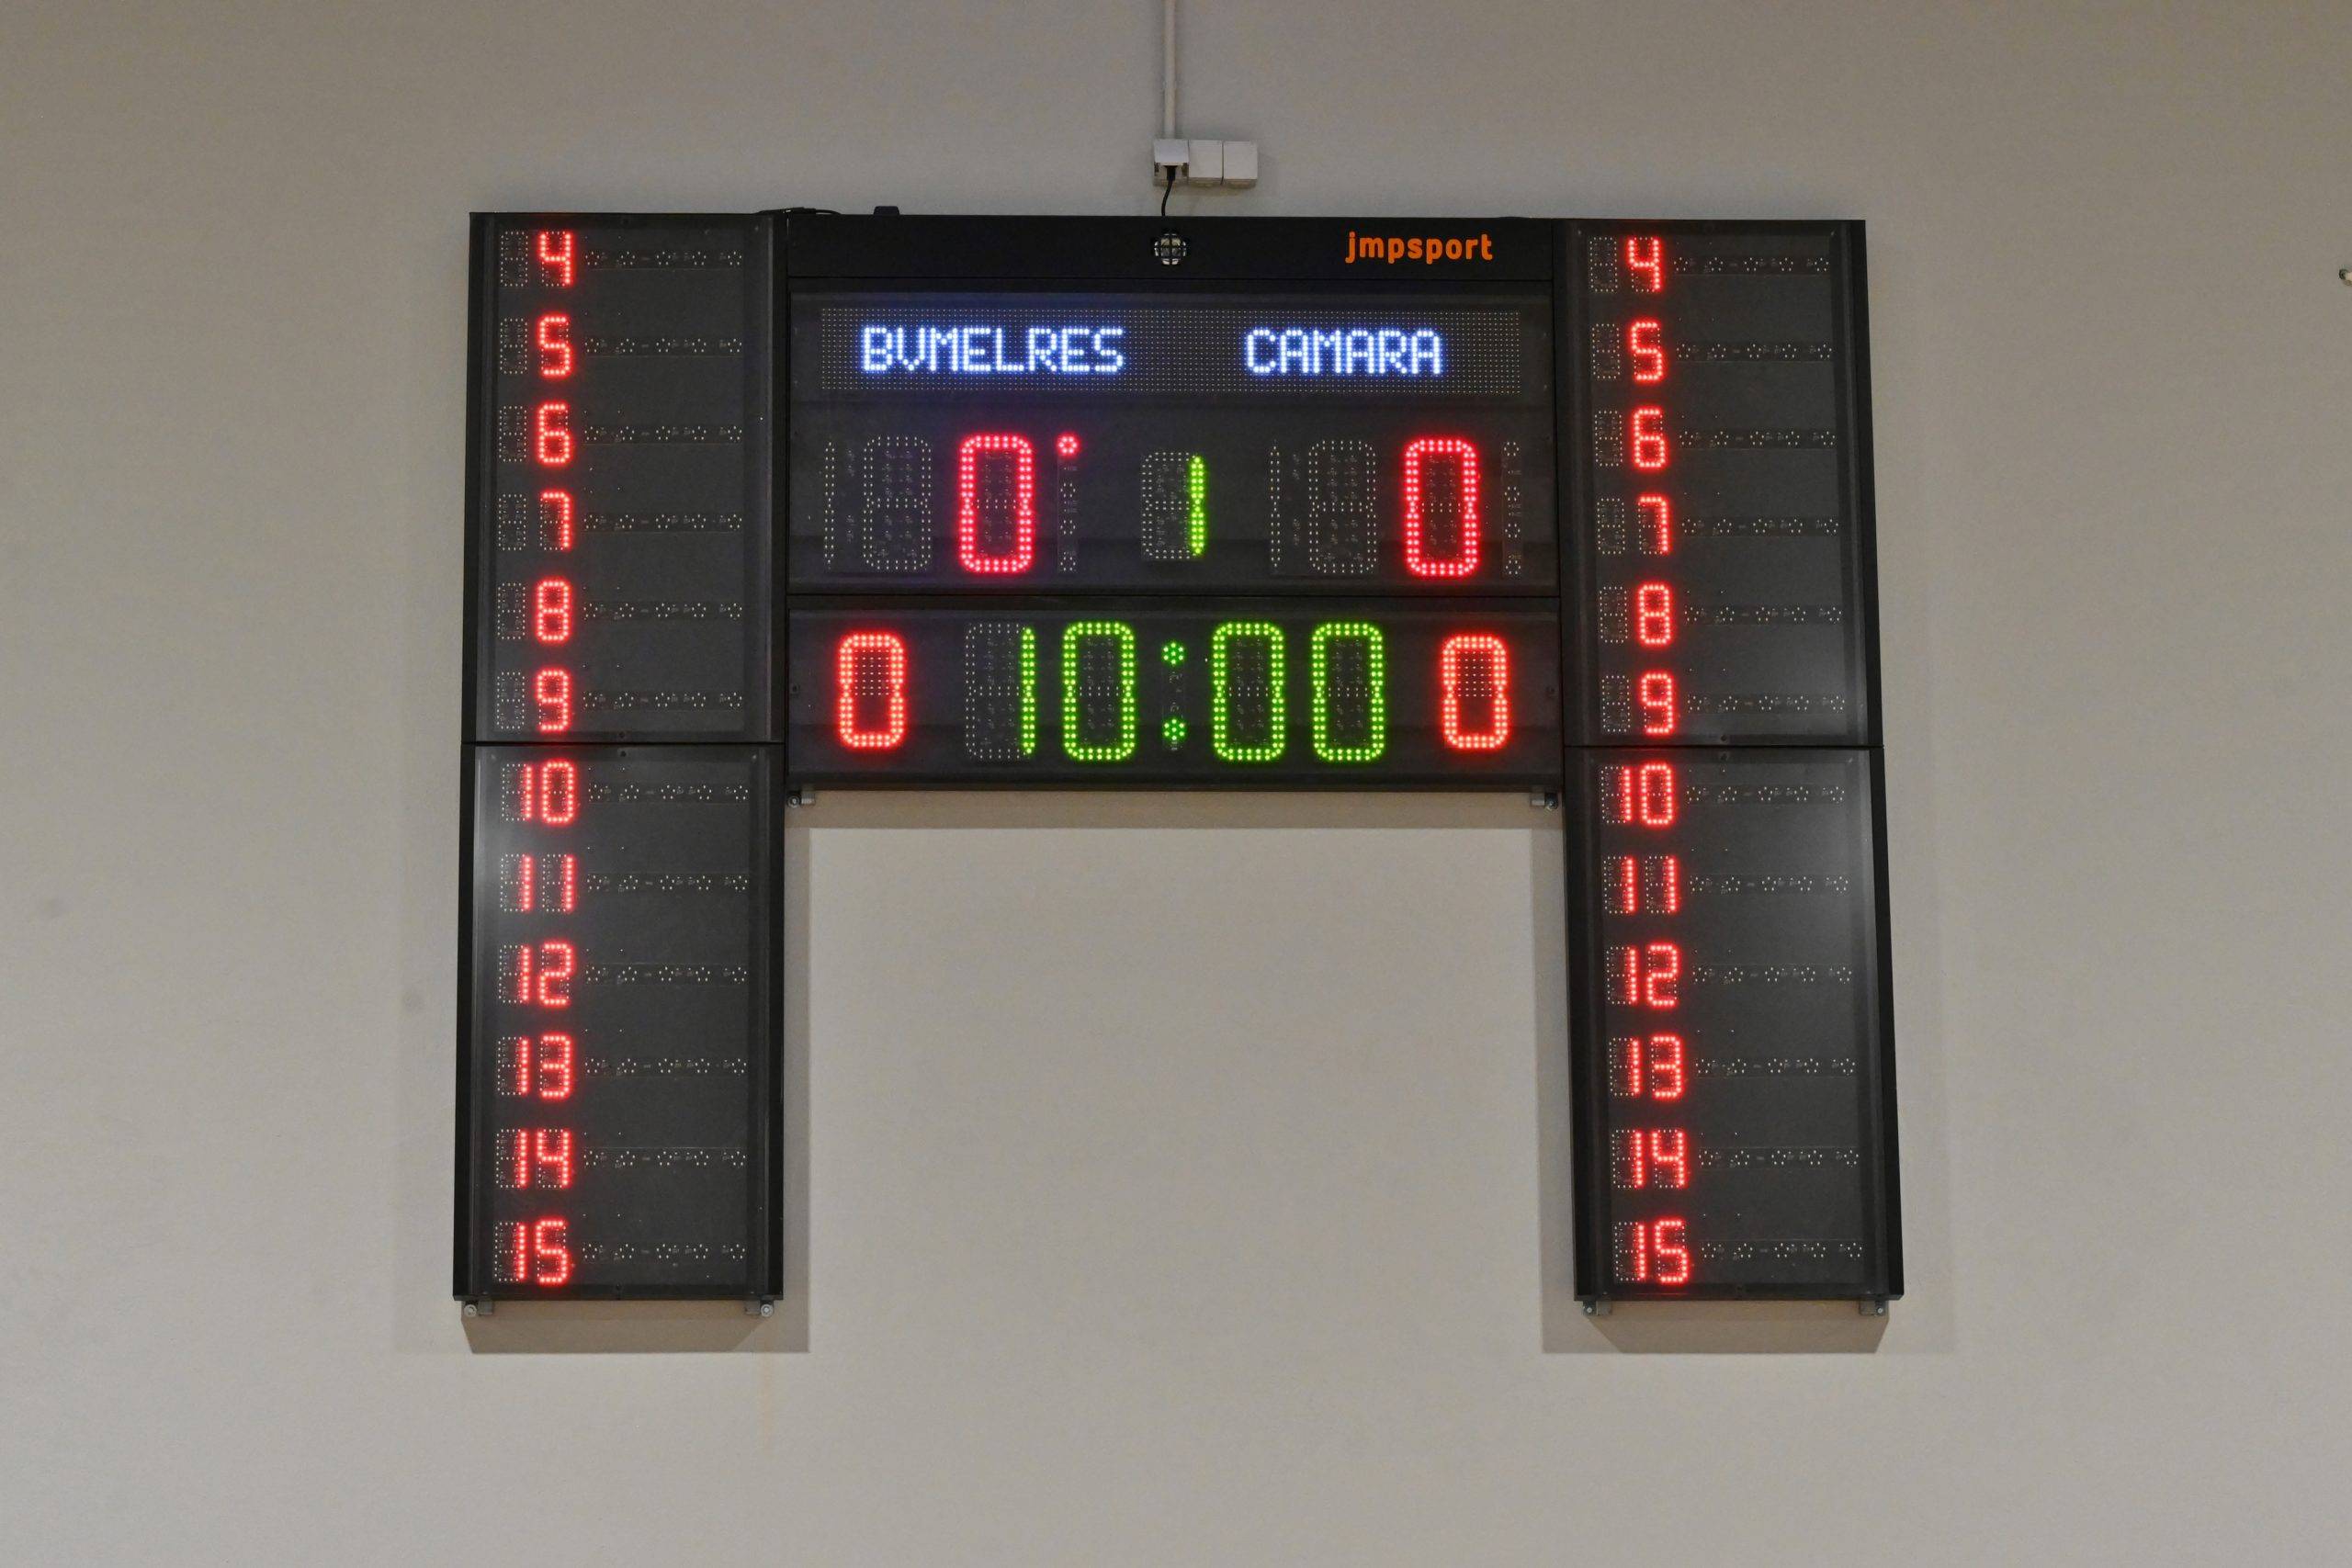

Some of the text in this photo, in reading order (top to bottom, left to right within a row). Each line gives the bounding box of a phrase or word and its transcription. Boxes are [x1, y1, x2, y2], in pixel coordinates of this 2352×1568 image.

[539, 232, 572, 286] 4
[1346, 232, 1492, 264] jmpsport
[1628, 238, 1661, 291] 4
[539, 316, 571, 376] 5
[861, 325, 1125, 375] BVMELRES
[1244, 327, 1443, 377] CAMARA
[1631, 321, 1663, 382] 5
[538, 403, 571, 464] 6
[1633, 407, 1668, 468] 6
[541, 492, 571, 549] 7
[959, 435, 1033, 572] 0
[1405, 439, 1480, 576] 0
[1638, 496, 1668, 553] 7
[537, 581, 571, 642] 8
[1638, 584, 1672, 646] 8
[537, 670, 570, 731] 9
[839, 634, 907, 748] 0
[1022, 623, 1384, 761] 10:00
[1442, 636, 1508, 749] 0
[1641, 672, 1674, 735] 9
[523, 761, 574, 823] 10
[1623, 763, 1674, 825] 10
[522, 855, 573, 911] 11
[1624, 856, 1677, 913] 11
[518, 942, 573, 1006] 12
[1626, 944, 1678, 1007] 12
[517, 1034, 571, 1098] 13
[1629, 1036, 1683, 1099] 13
[516, 1130, 571, 1187] 14
[1633, 1130, 1686, 1188] 14
[514, 1220, 568, 1283] 15
[1636, 1220, 1689, 1283] 15
